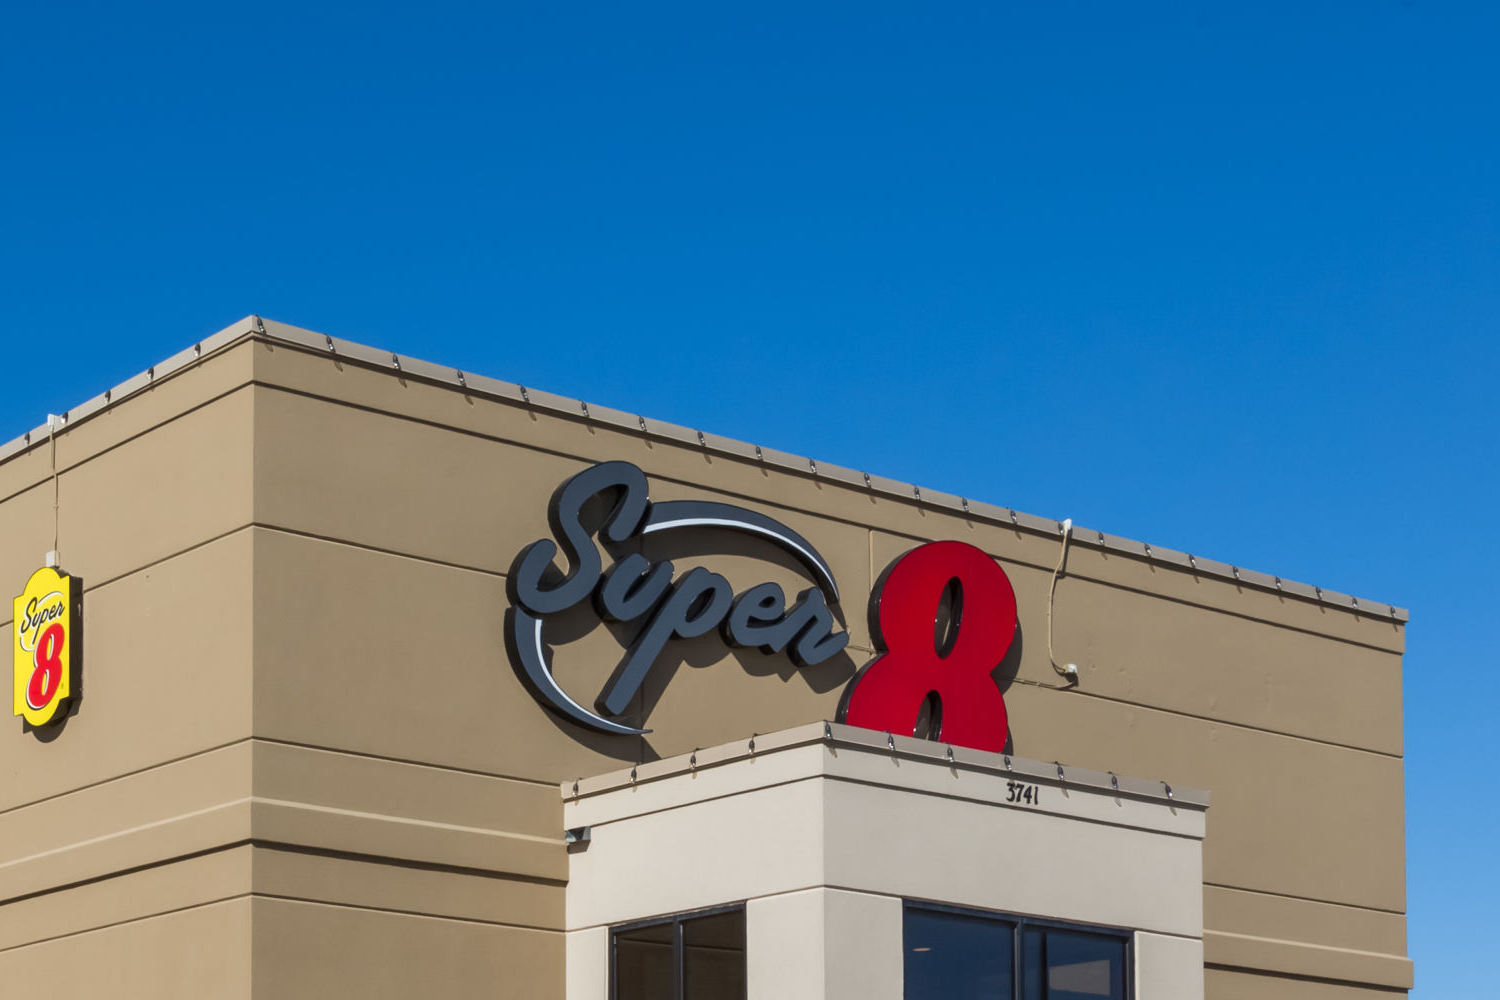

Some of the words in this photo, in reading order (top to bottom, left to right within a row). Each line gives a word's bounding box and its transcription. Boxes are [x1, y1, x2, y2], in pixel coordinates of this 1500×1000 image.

[21, 597, 65, 645] Super
[507, 460, 849, 716] Super
[836, 540, 1018, 753] 8
[27, 623, 65, 709] 8
[1005, 782, 1039, 805] 3741
